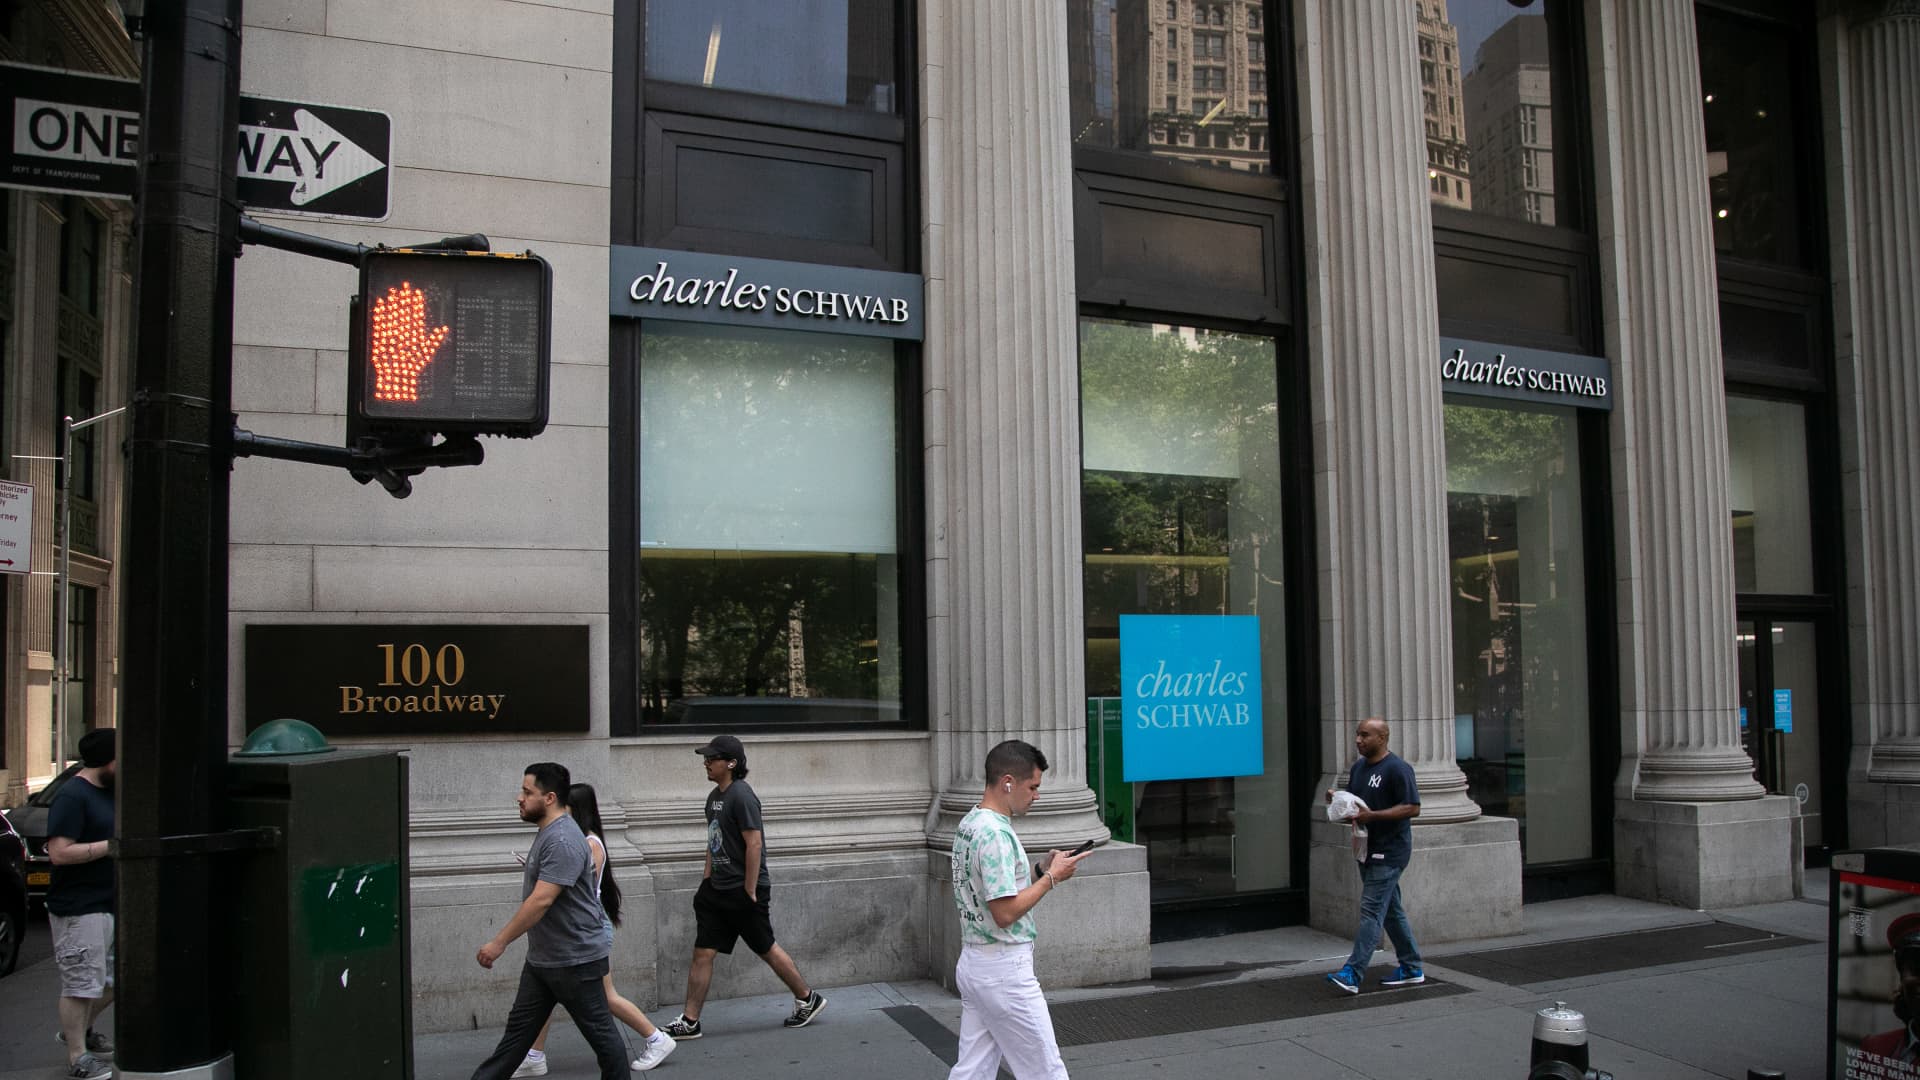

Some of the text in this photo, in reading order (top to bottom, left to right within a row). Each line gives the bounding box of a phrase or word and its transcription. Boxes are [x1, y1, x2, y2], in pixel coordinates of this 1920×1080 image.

[29, 106, 139, 162] ONE
[629, 261, 910, 323] charles SCHWAB
[1442, 348, 1607, 397] charles SCHWAB
[376, 643, 466, 687] 100
[1136, 659, 1249, 699] charles
[339, 685, 505, 719] Broadway
[1136, 703, 1250, 729] SCHWAB
[1845, 1046, 1881, 1064] WE'VE
[1882, 1056, 1914, 1074] BEEN
[1846, 1057, 1886, 1077] LOWER
